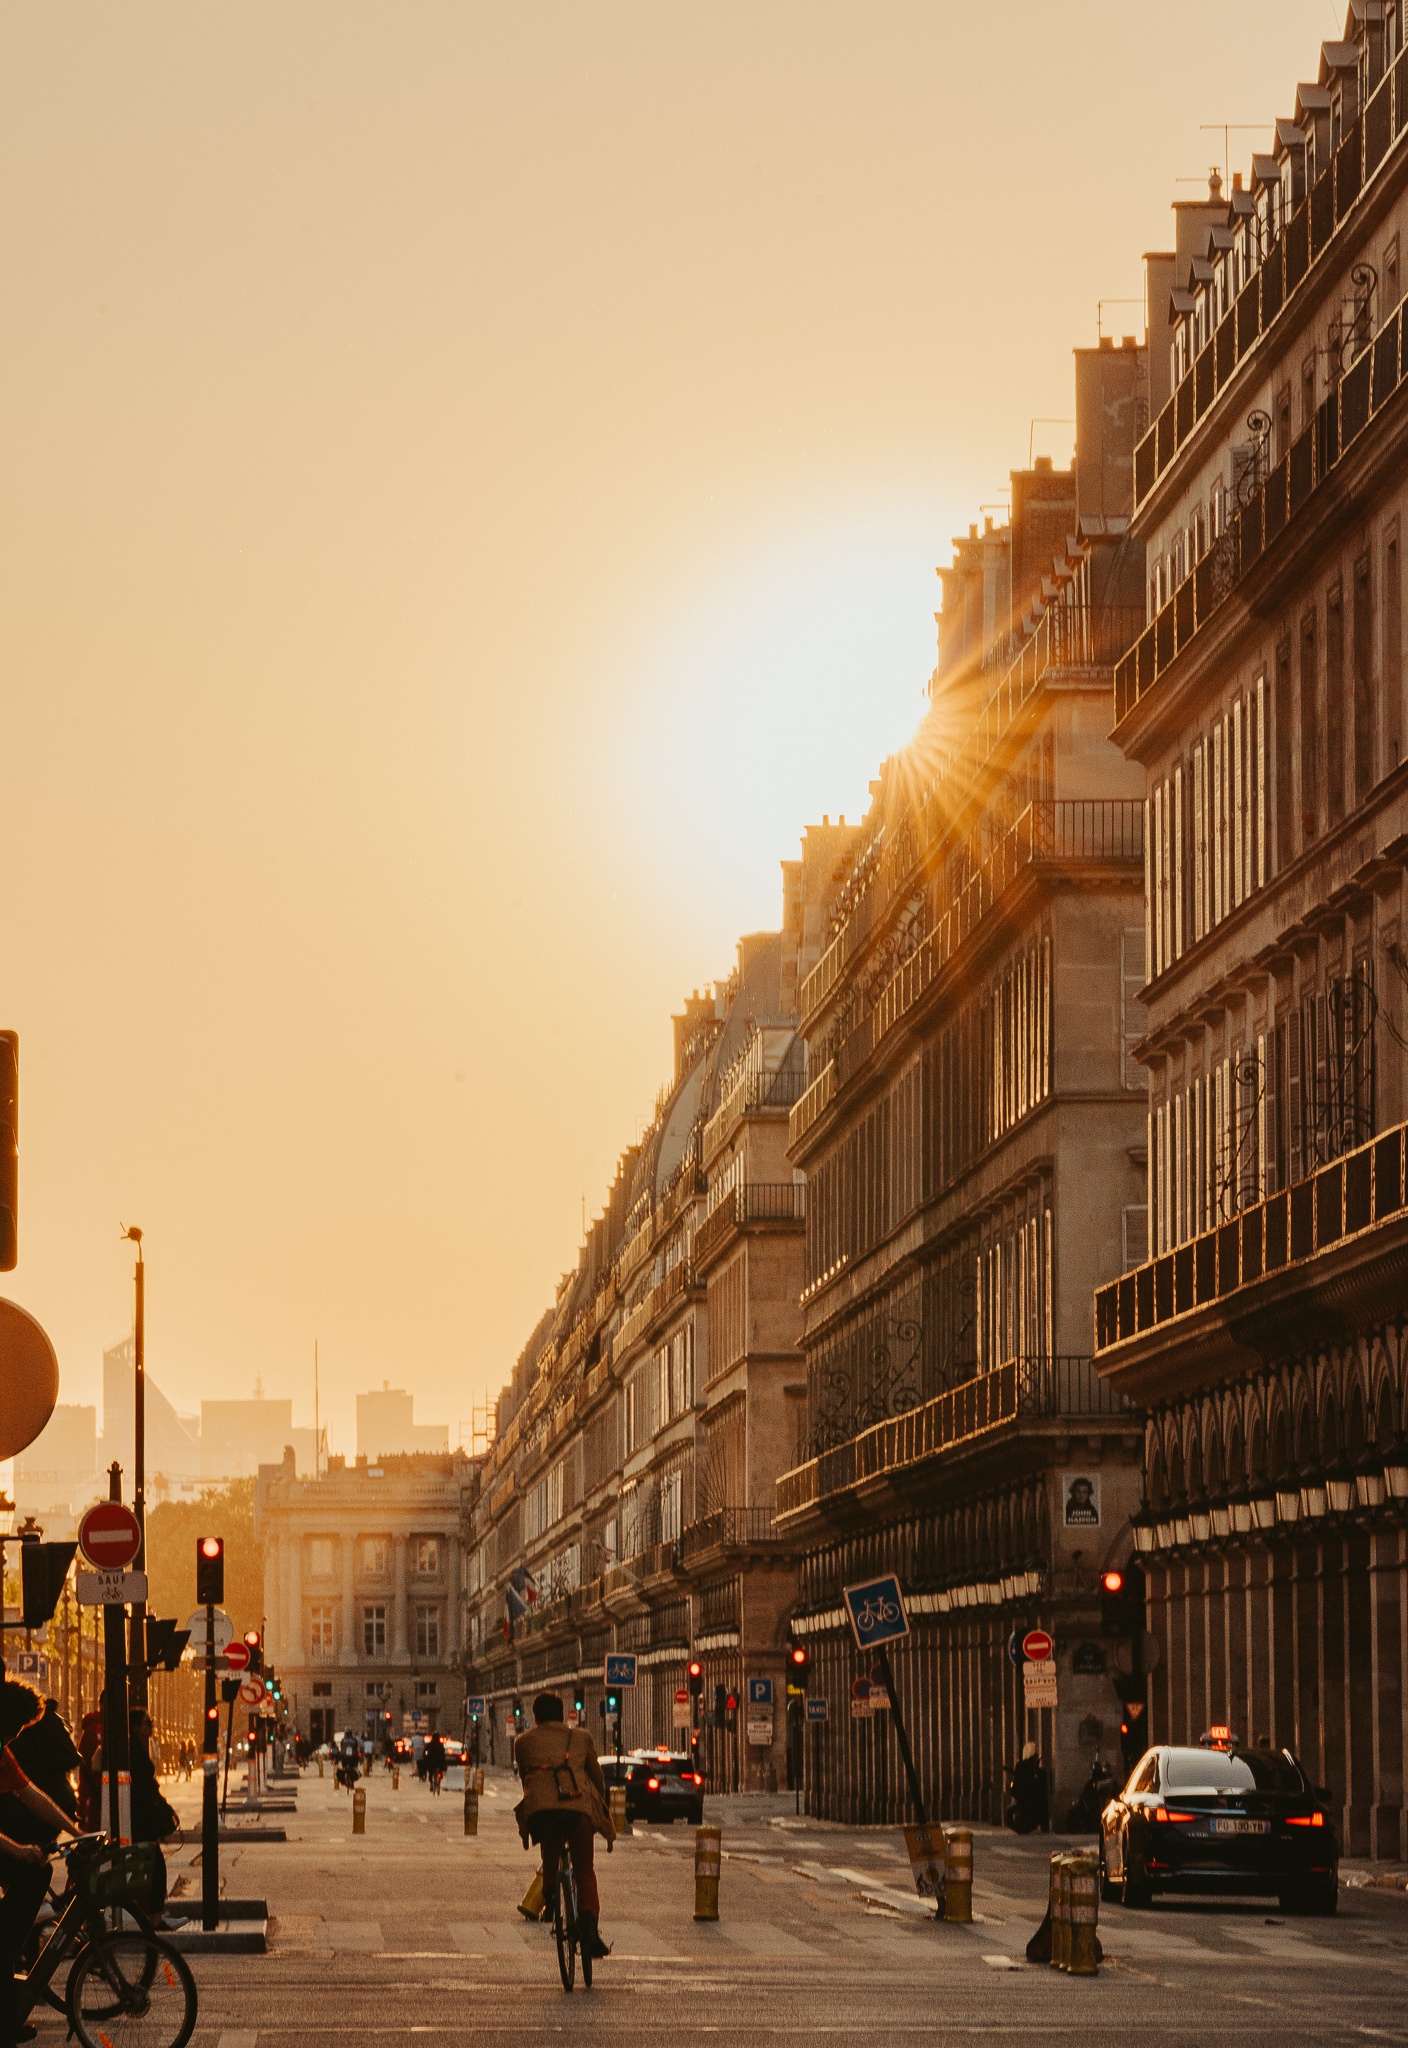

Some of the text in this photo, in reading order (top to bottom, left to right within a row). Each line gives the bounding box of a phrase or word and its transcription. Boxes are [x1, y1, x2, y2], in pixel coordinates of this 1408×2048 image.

[98, 1575, 126, 1585] SAUF
[23, 1656, 34, 1671] P
[755, 1682, 766, 1700] P
[808, 1706, 826, 1714] TAXIS
